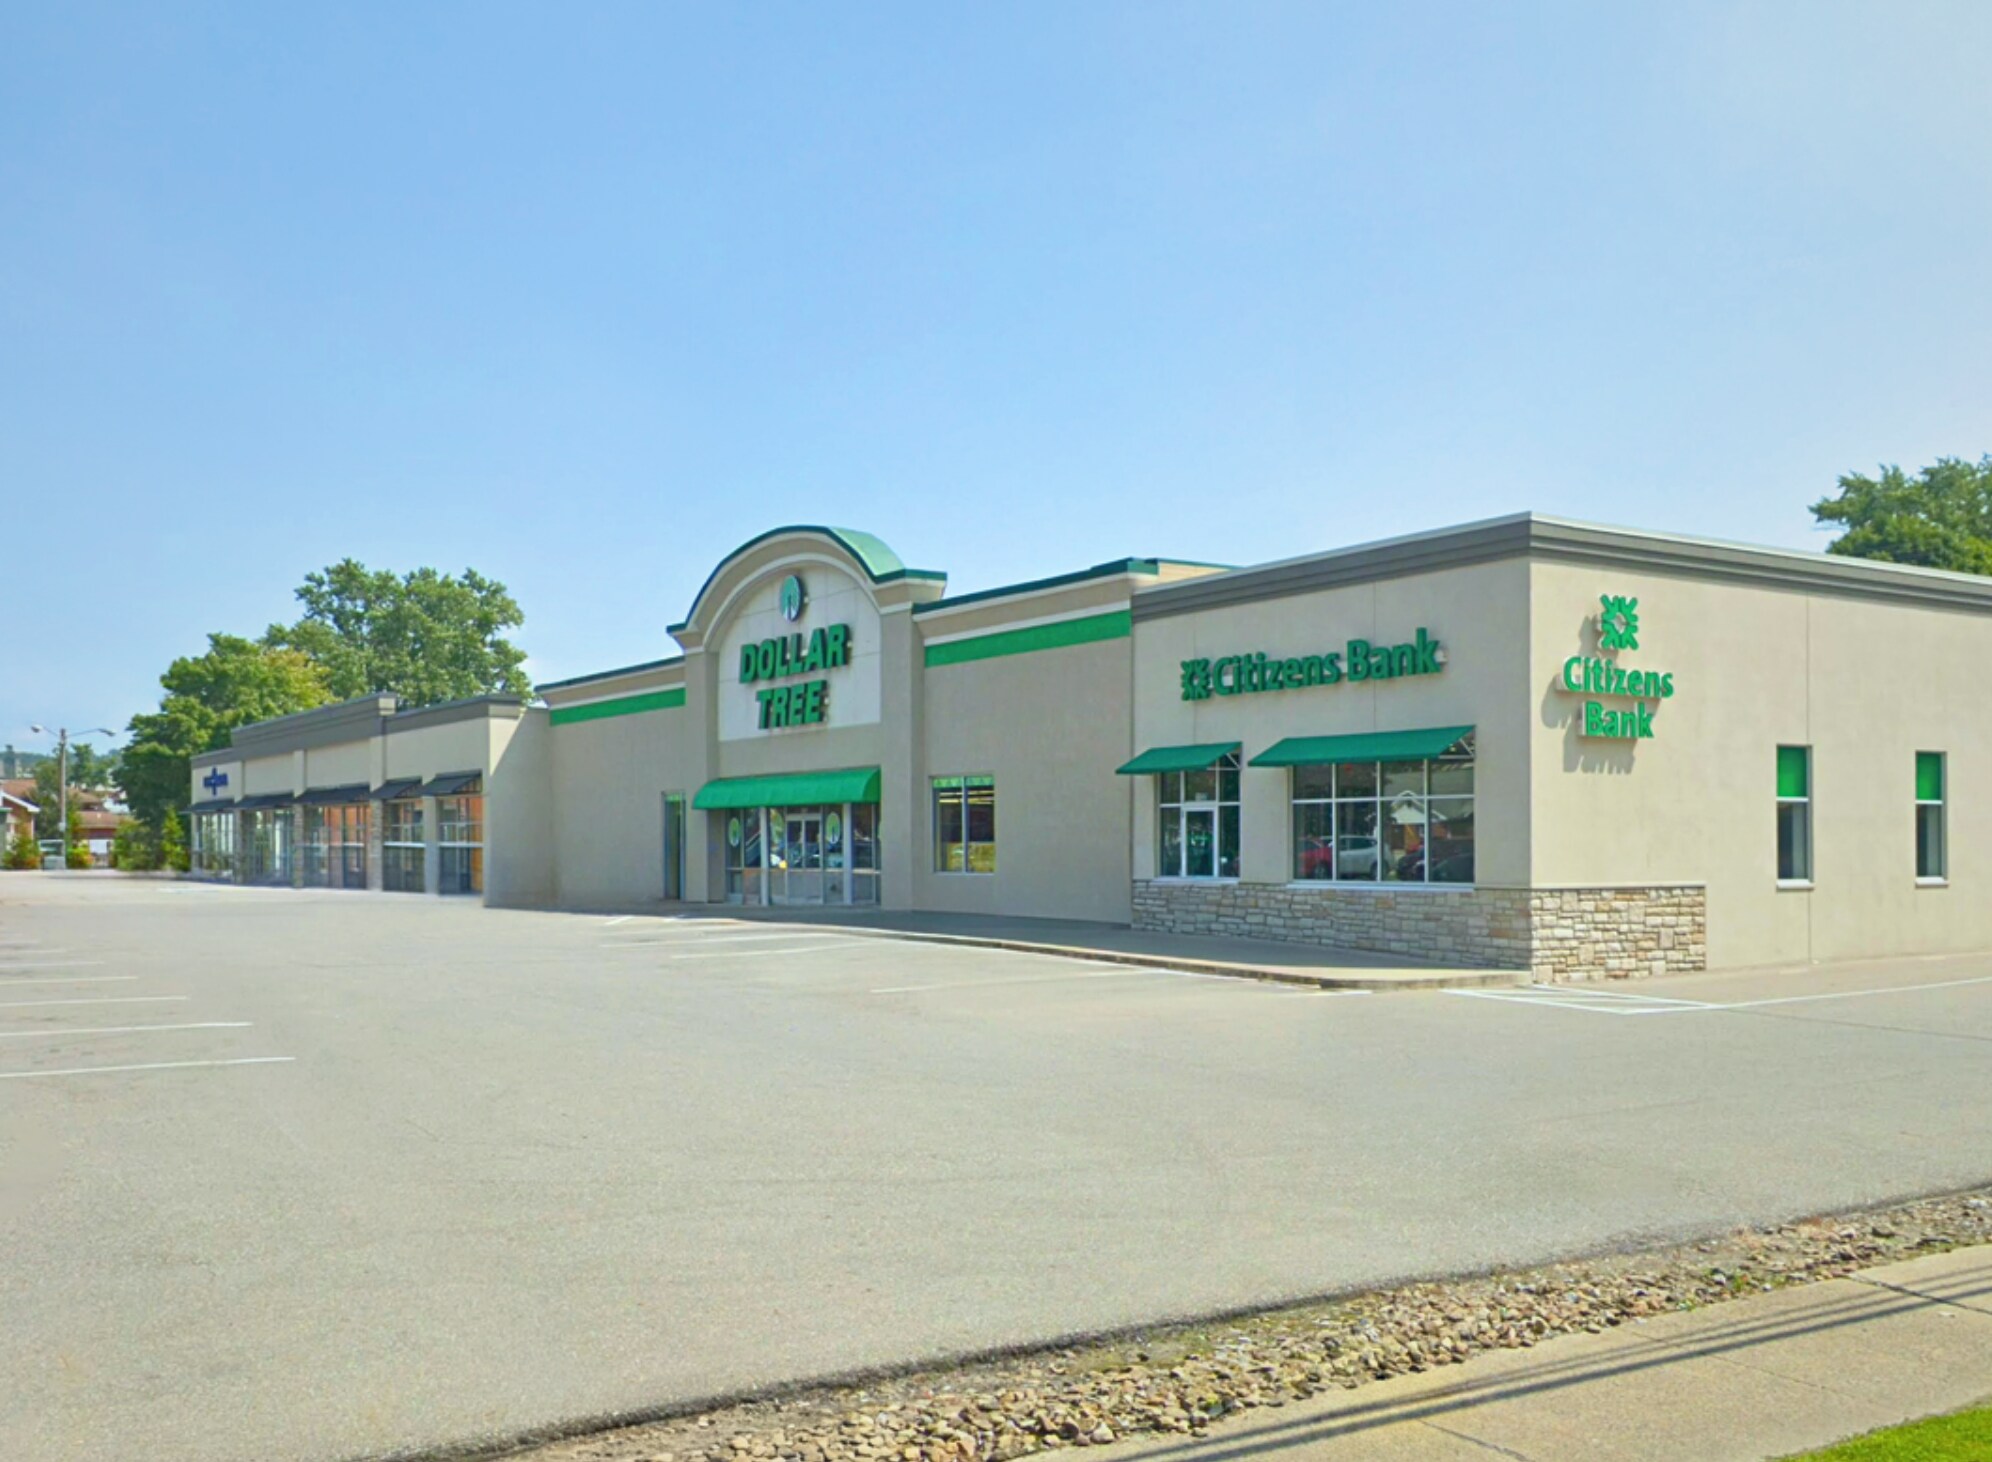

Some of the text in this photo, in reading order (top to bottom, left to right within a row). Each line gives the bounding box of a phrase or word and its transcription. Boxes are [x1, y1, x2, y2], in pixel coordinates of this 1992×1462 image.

[740, 623, 850, 683] DOLLAR
[1213, 627, 1441, 696] Citizens Bank
[1563, 656, 1674, 698] Citizens
[756, 680, 827, 729] TREE
[1585, 701, 1654, 738] Bank
